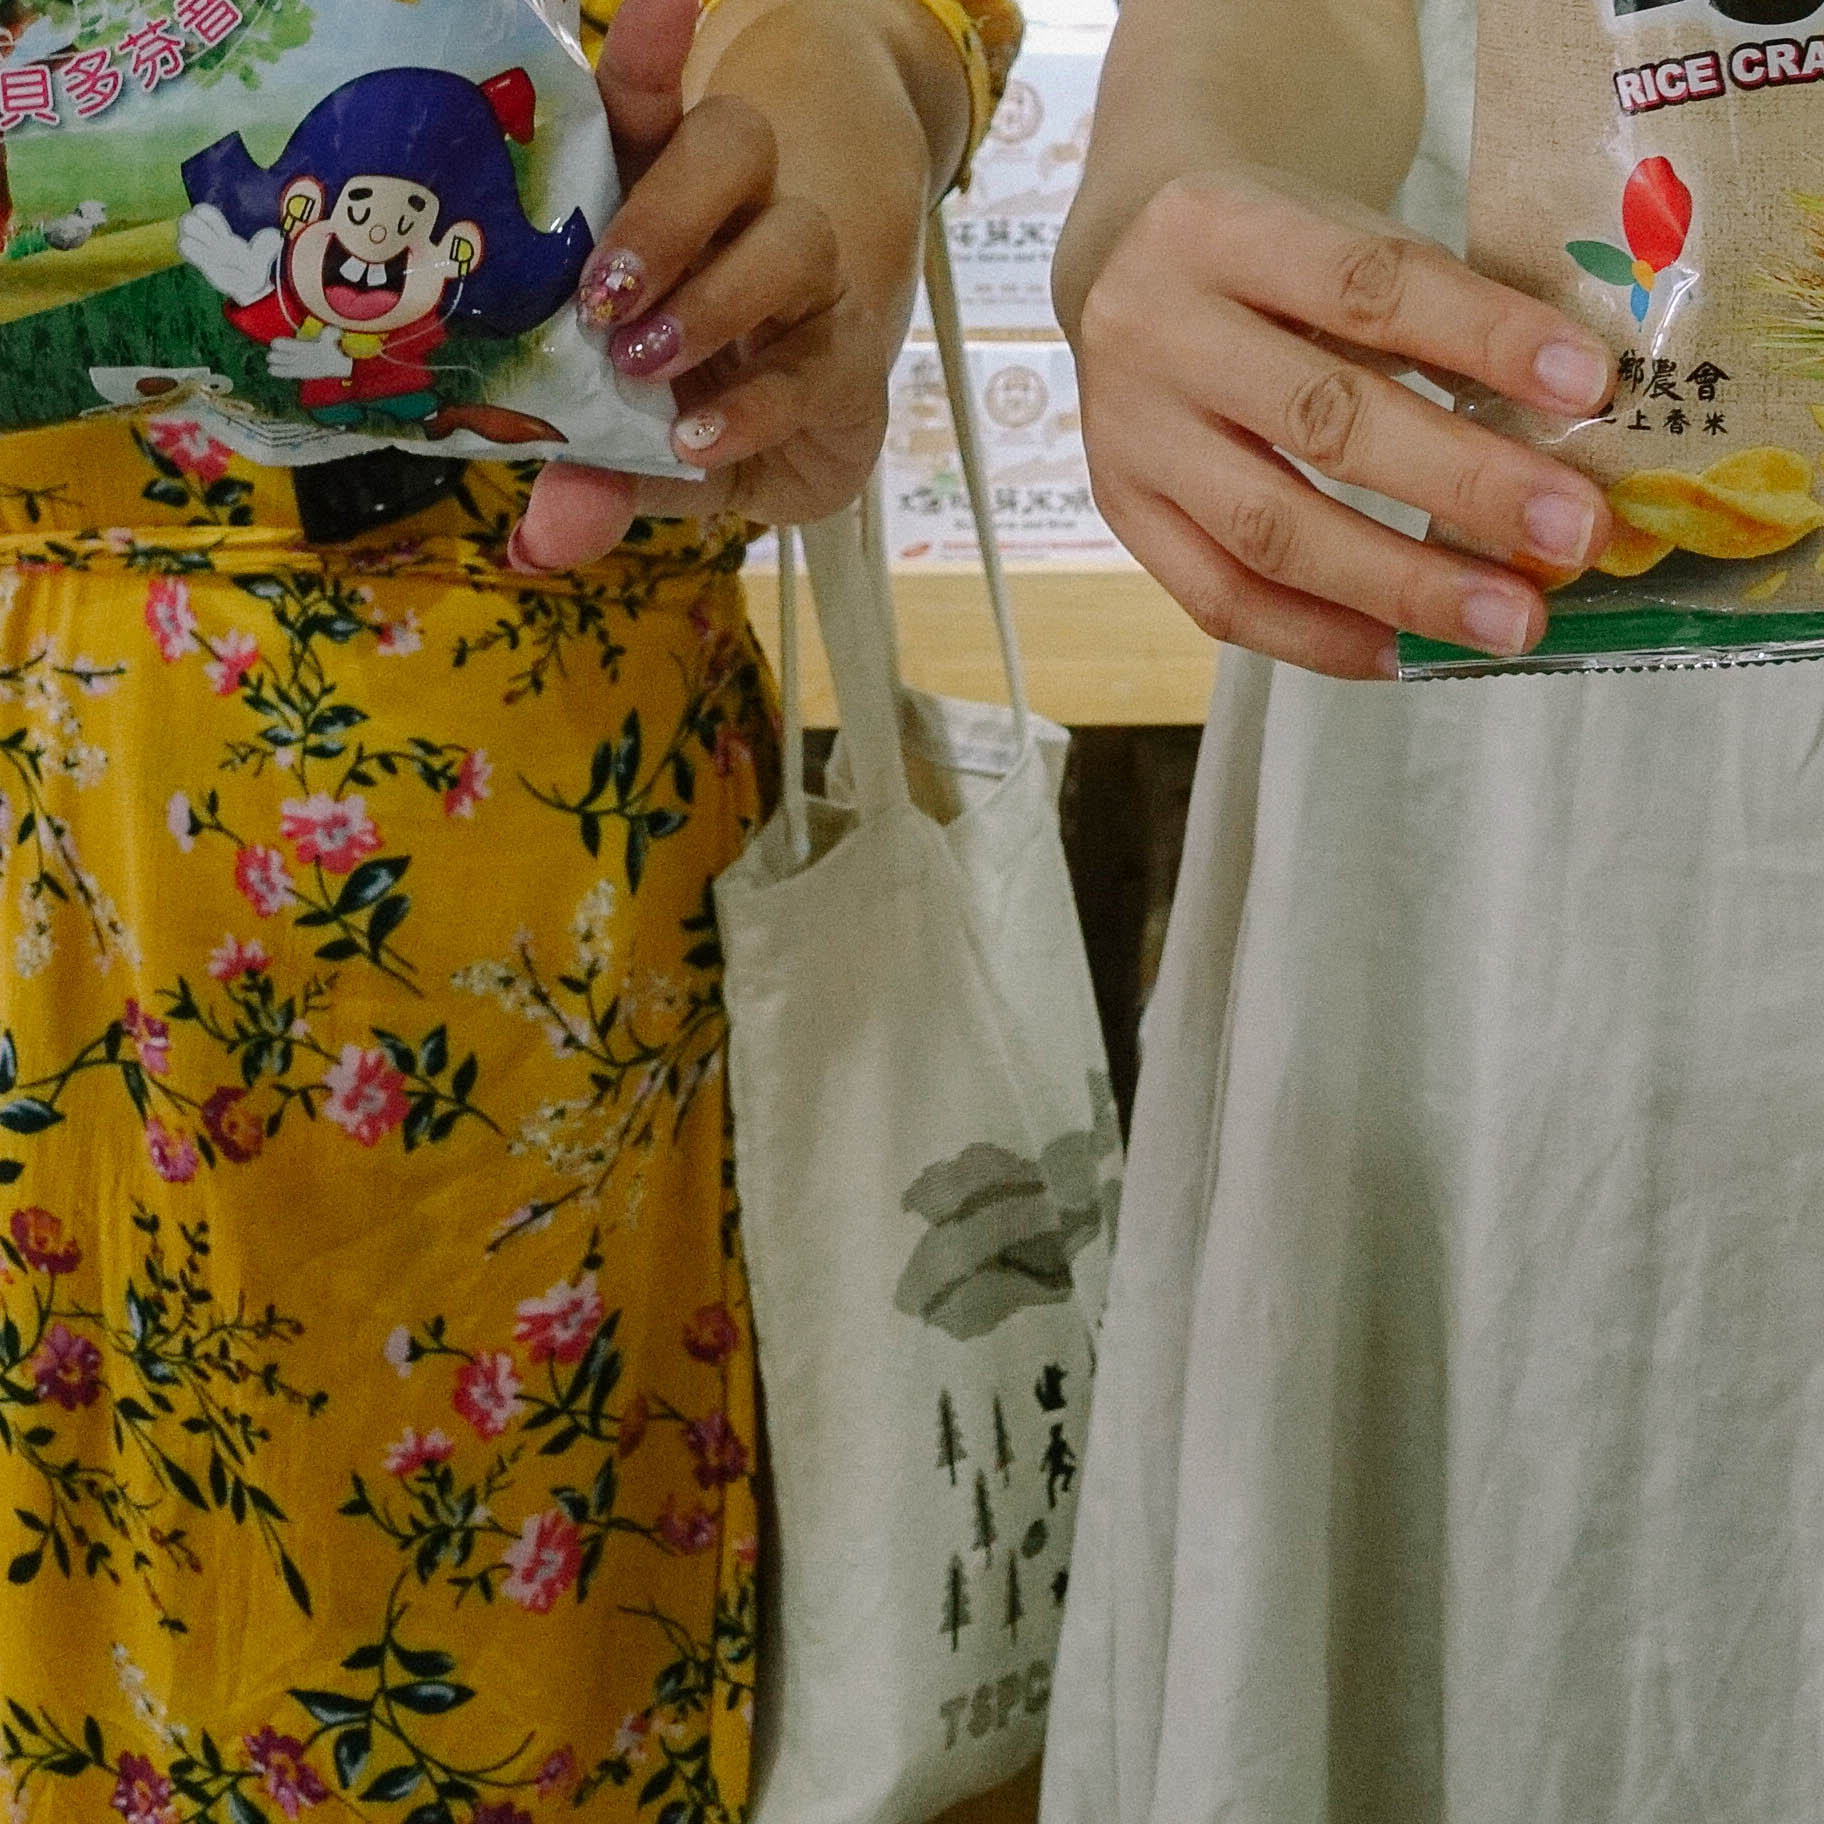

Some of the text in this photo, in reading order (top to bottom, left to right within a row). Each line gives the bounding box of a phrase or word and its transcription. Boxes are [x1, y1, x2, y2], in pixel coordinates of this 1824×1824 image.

[1616, 57, 1719, 111] RICE
[1602, 407, 1729, 436] 上香米
